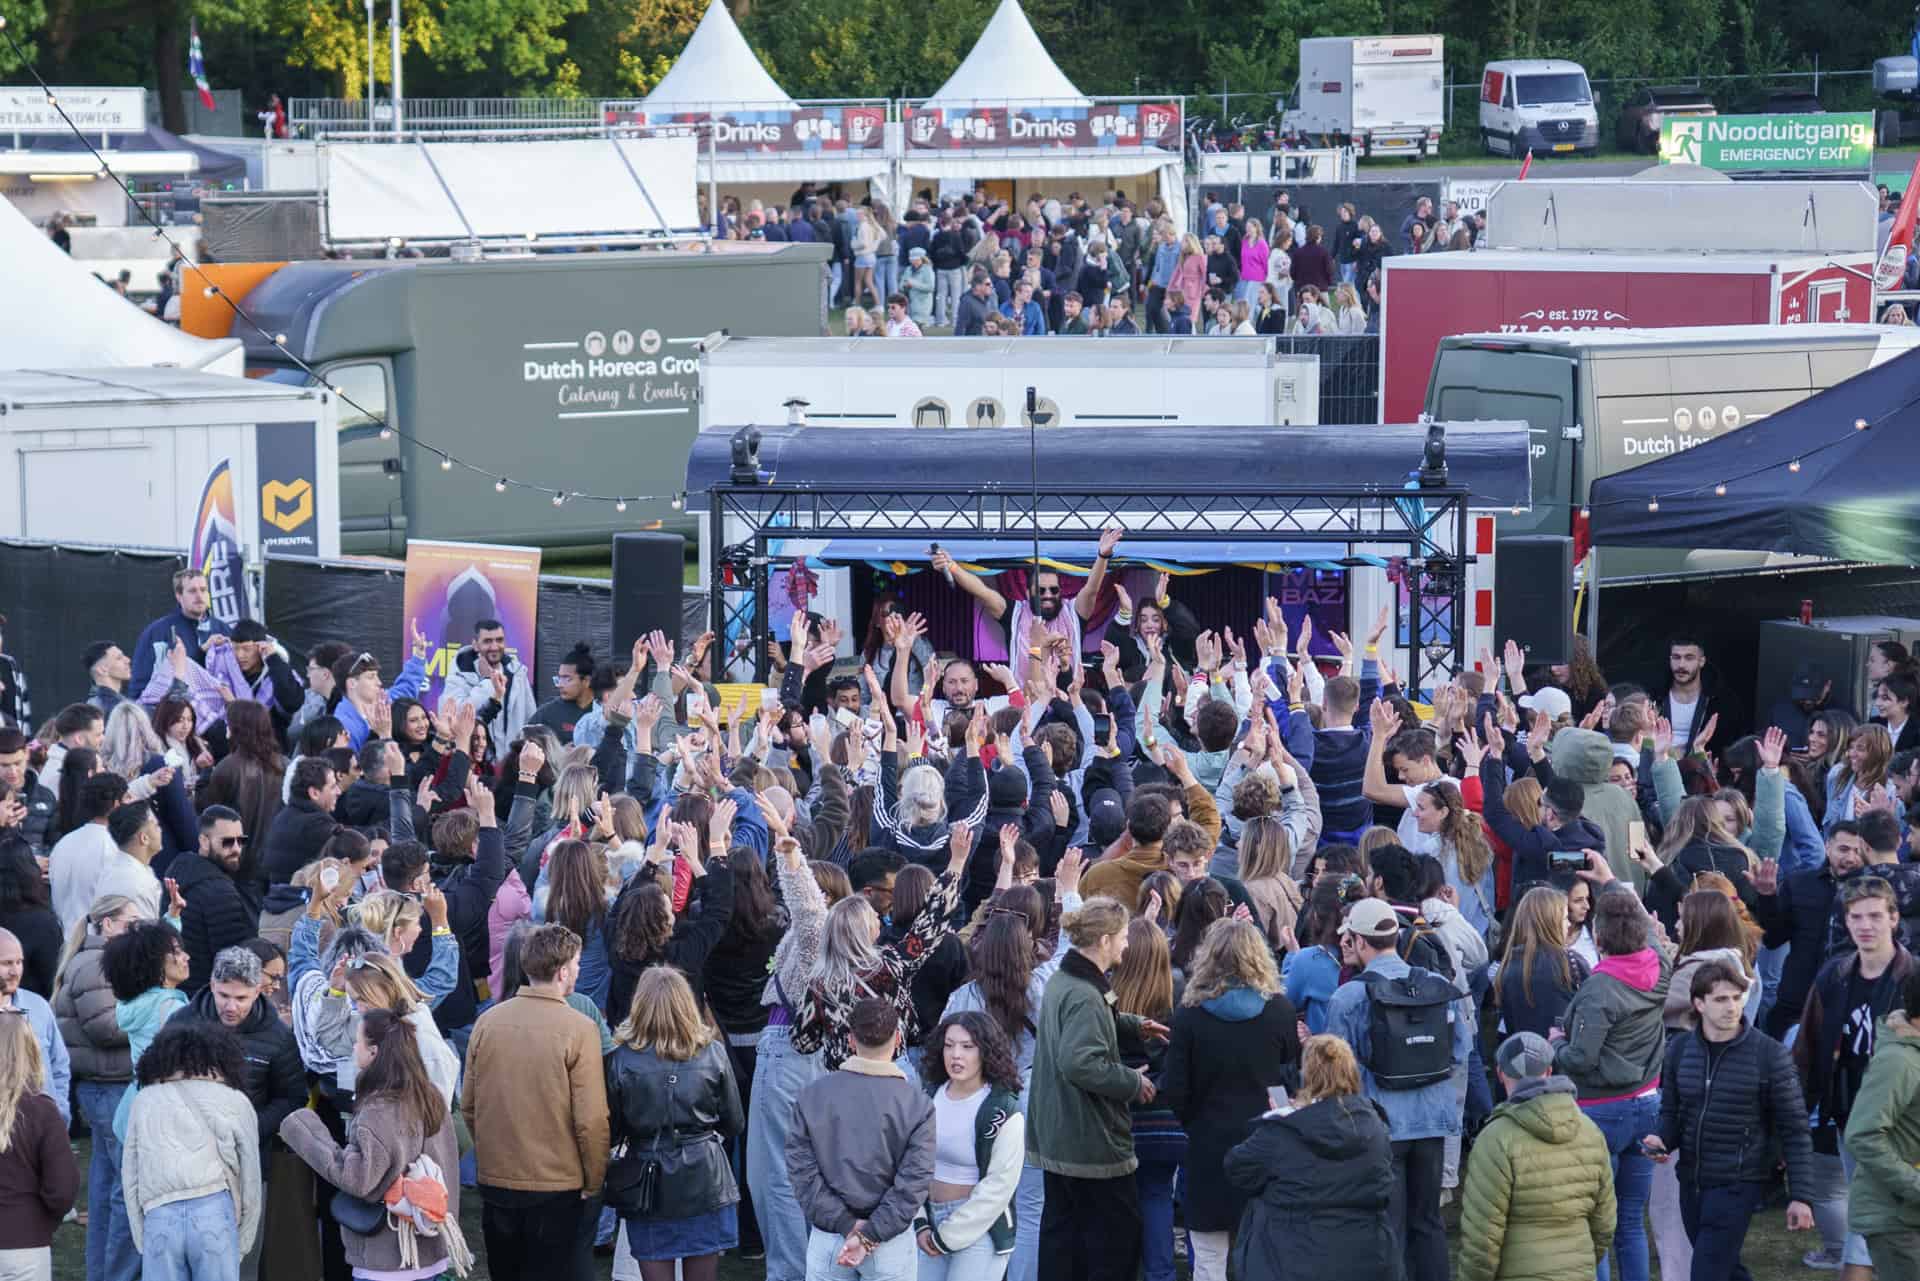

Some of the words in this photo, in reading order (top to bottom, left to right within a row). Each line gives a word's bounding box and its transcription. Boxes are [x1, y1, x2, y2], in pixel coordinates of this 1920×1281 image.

[714, 122, 781, 142] Drinks
[1010, 118, 1077, 138] Drinks
[1708, 120, 1865, 145] Nooduitgang
[1720, 148, 1818, 162] EMERGENCY
[1819, 146, 1853, 160] EXIT
[1549, 309, 1569, 321] est.
[1572, 309, 1598, 320] 1972
[524, 360, 584, 380] Dutch
[589, 358, 657, 378] Horeca
[558, 384, 619, 408] Catering
[628, 382, 636, 400] &
[643, 380, 688, 402] Events
[1623, 434, 1675, 456] Dutch
